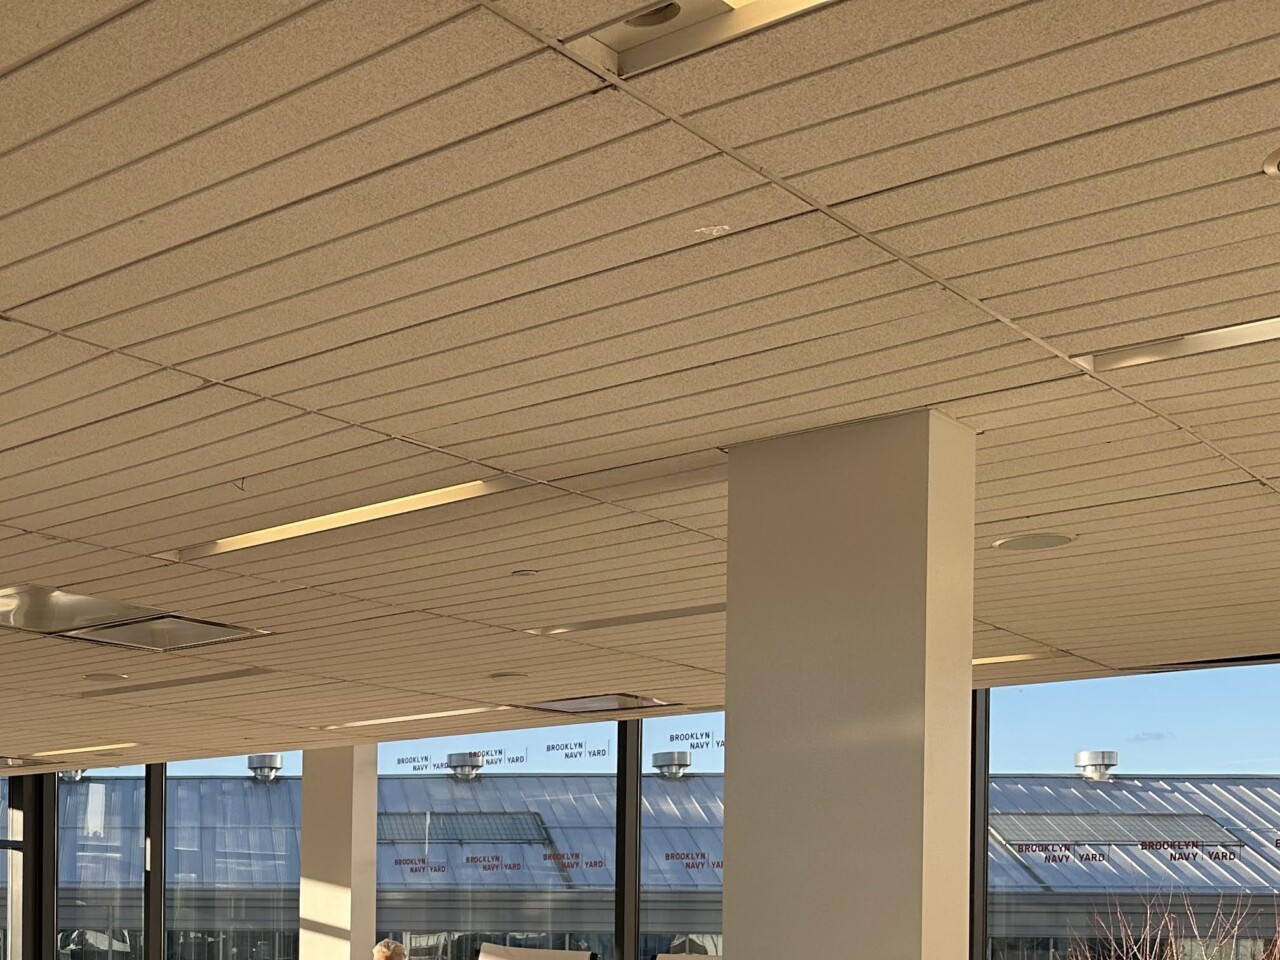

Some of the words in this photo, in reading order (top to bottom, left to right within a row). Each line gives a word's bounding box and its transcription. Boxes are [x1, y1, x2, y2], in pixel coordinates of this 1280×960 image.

[669, 731, 710, 742] BROOKLYN
[546, 742, 583, 752] BROOKLYN
[690, 741, 710, 750] NAVY
[715, 740, 724, 748] YA
[468, 749, 503, 758] BROOKLYN
[564, 751, 583, 759] NAVY
[588, 749, 606, 757] YARD
[397, 756, 429, 765] BROOKLYN
[507, 756, 525, 764] YARD
[433, 762, 449, 770] YARD
[1018, 843, 1070, 853] BROOKLYN
[1140, 841, 1199, 850] BROOKLYN
[466, 855, 500, 863] BROOKLYN
[665, 852, 706, 861] BROOKLYN
[1044, 855, 1070, 863] NAVY
[1079, 853, 1105, 862] YARD
[1170, 852, 1199, 861] NAVY
[1208, 852, 1236, 861] YARD
[504, 863, 521, 871] YARD
[561, 861, 580, 869] NAVY
